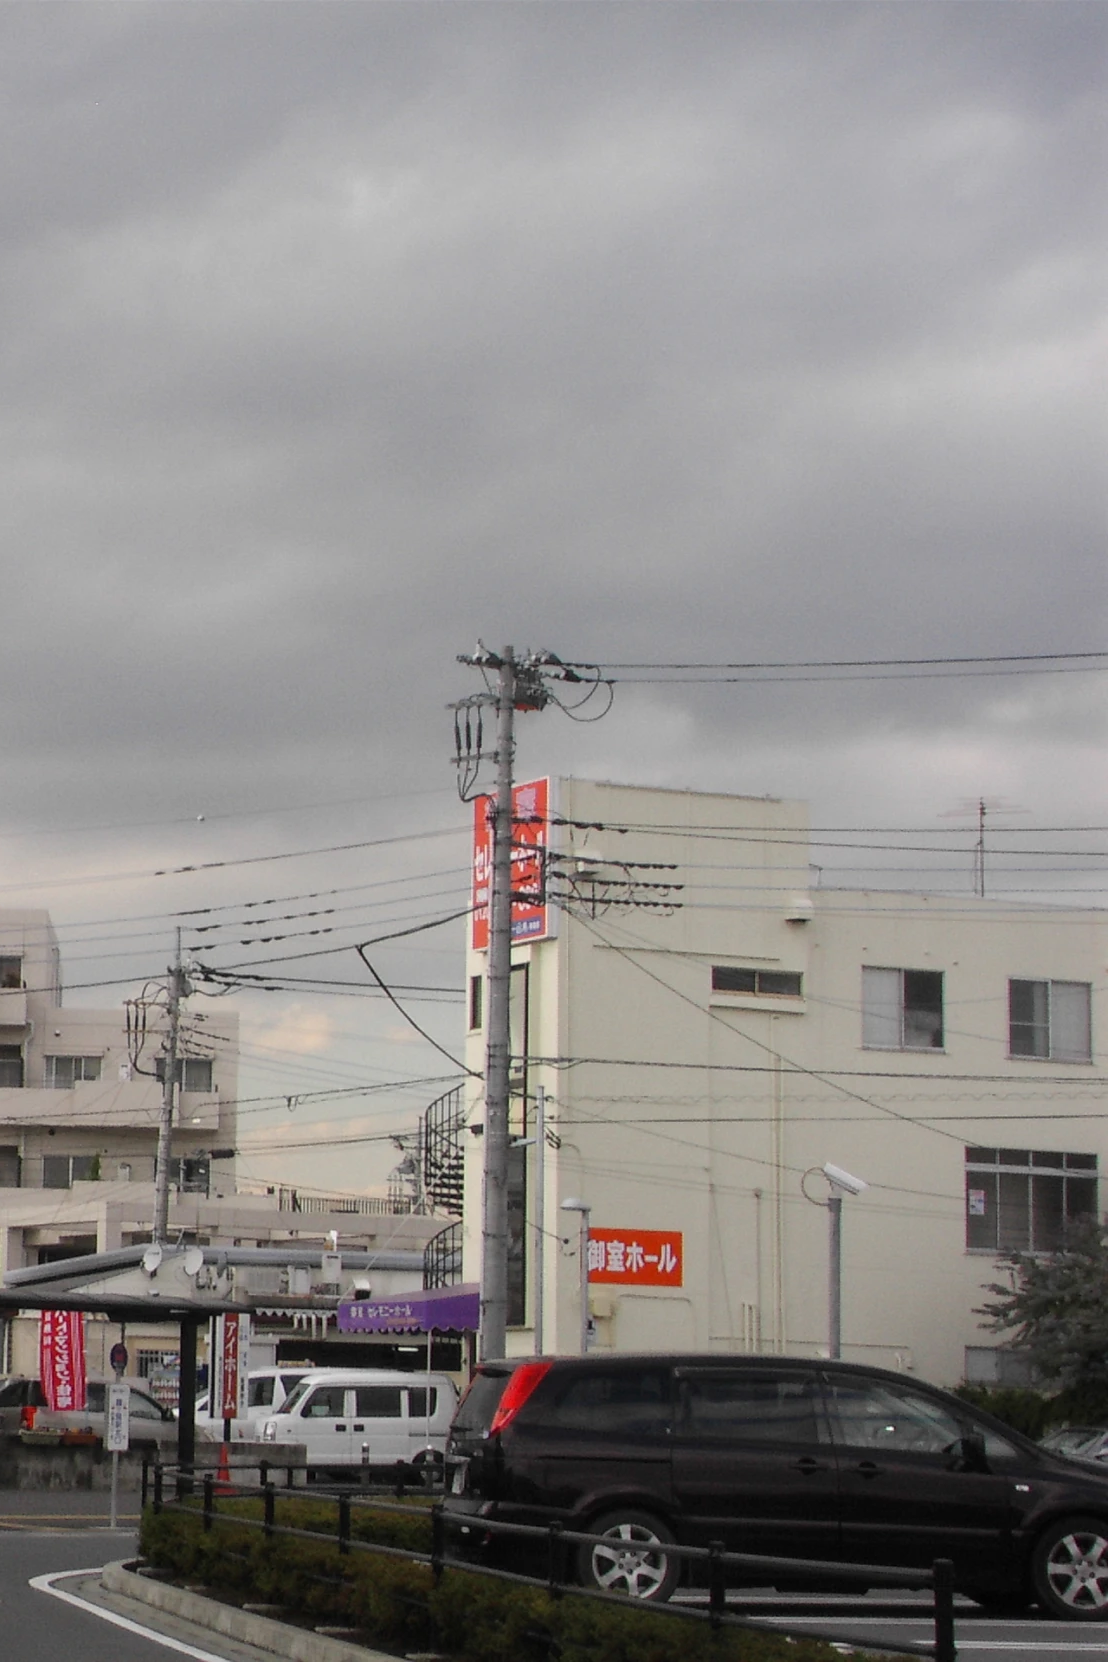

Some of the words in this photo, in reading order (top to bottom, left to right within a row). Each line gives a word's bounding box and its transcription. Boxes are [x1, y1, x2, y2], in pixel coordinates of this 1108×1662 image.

[224, 1321, 237, 1410] アイホーム
